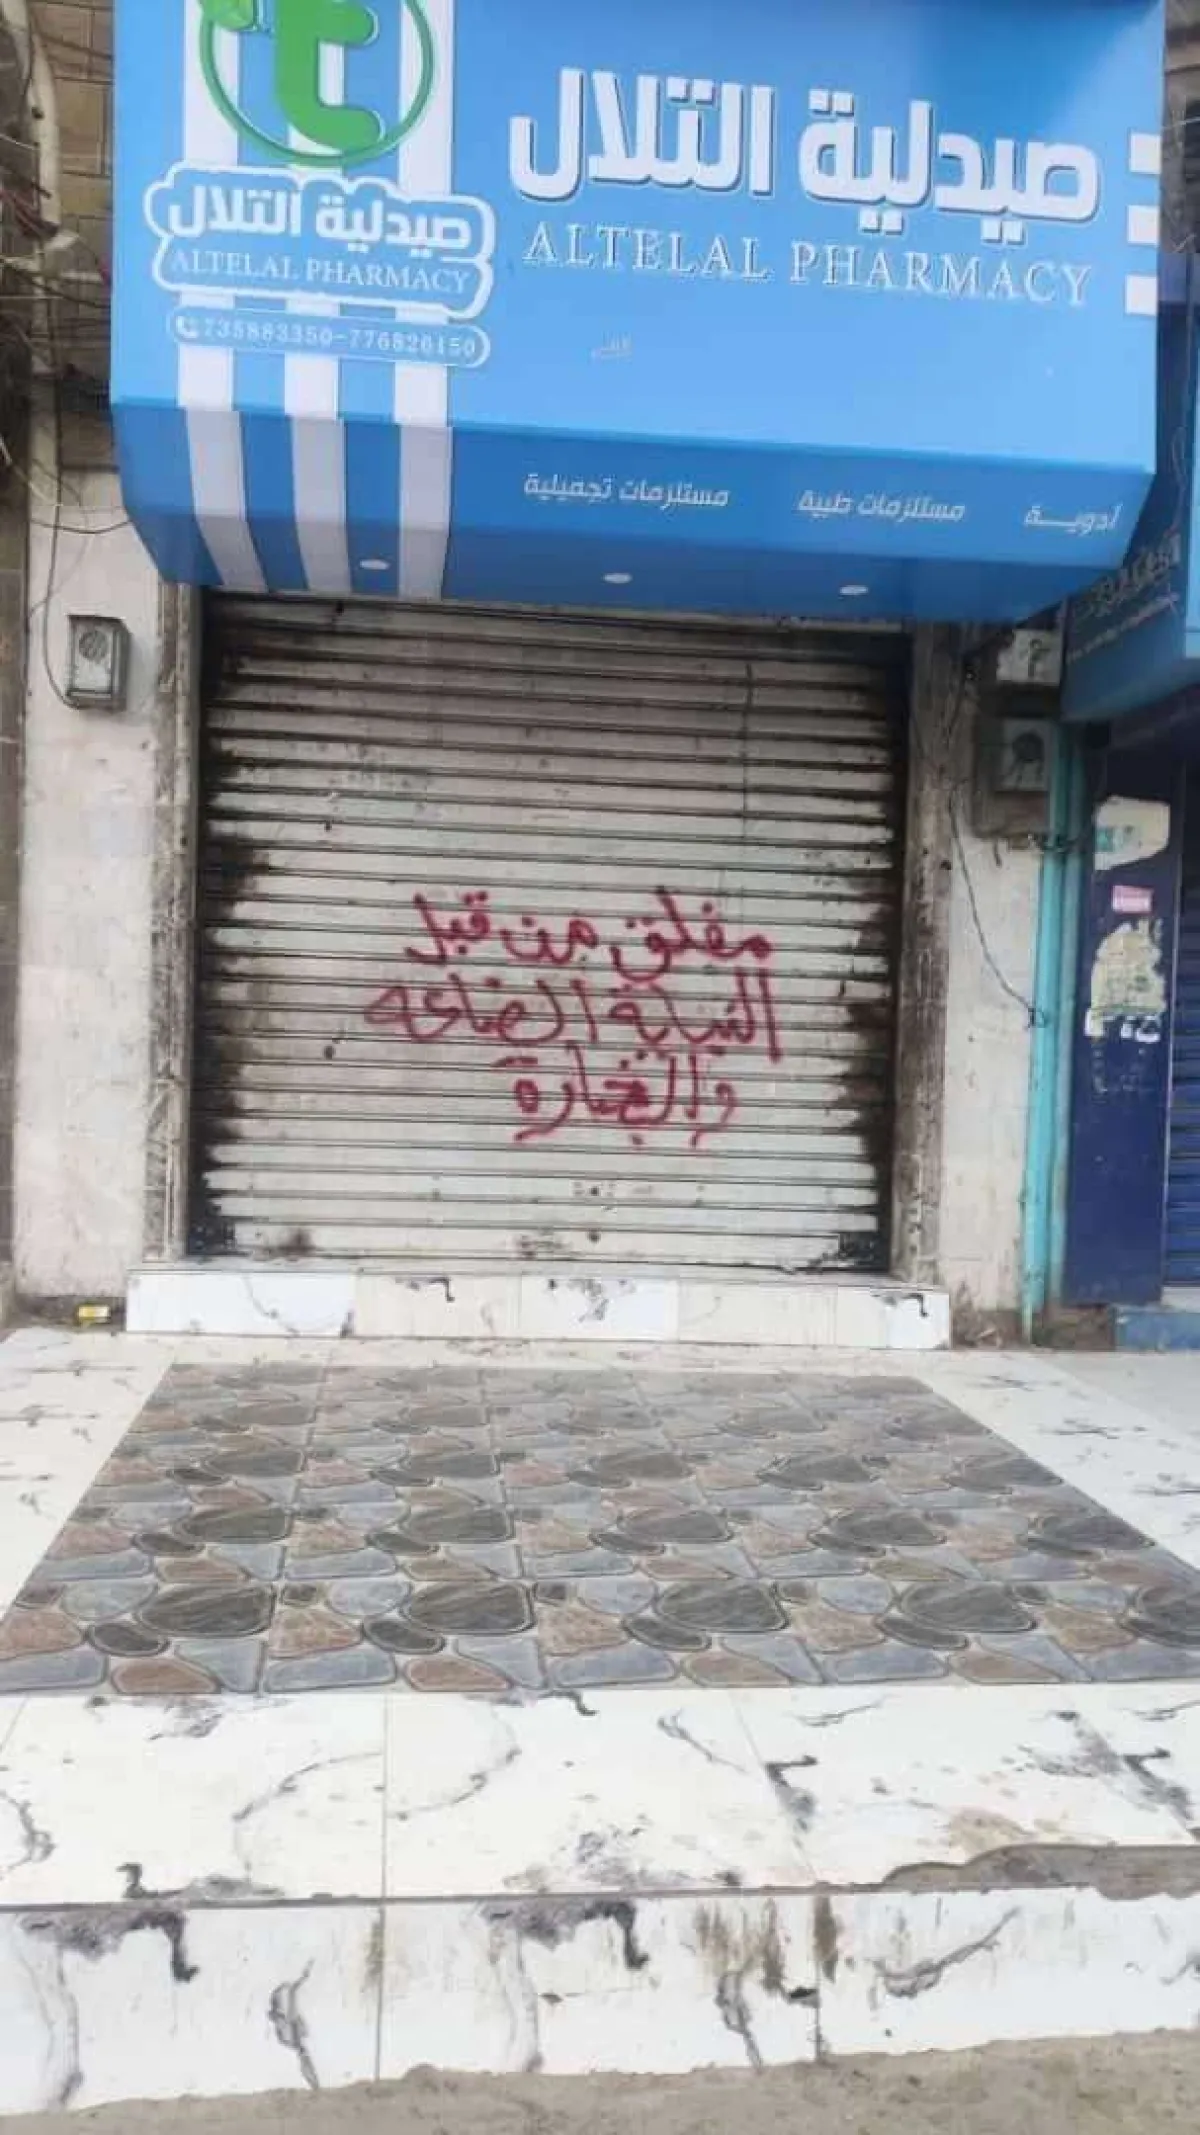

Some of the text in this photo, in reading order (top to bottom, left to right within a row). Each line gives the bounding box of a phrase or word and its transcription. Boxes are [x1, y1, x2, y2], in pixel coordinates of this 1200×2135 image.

[510, 66, 1101, 246] صيدلية التلال
[168, 184, 471, 258] صيدلية التلال
[170, 248, 470, 293] ALTELAL PHARMACY
[522, 221, 1092, 307] ALTELAL PHARMACY
